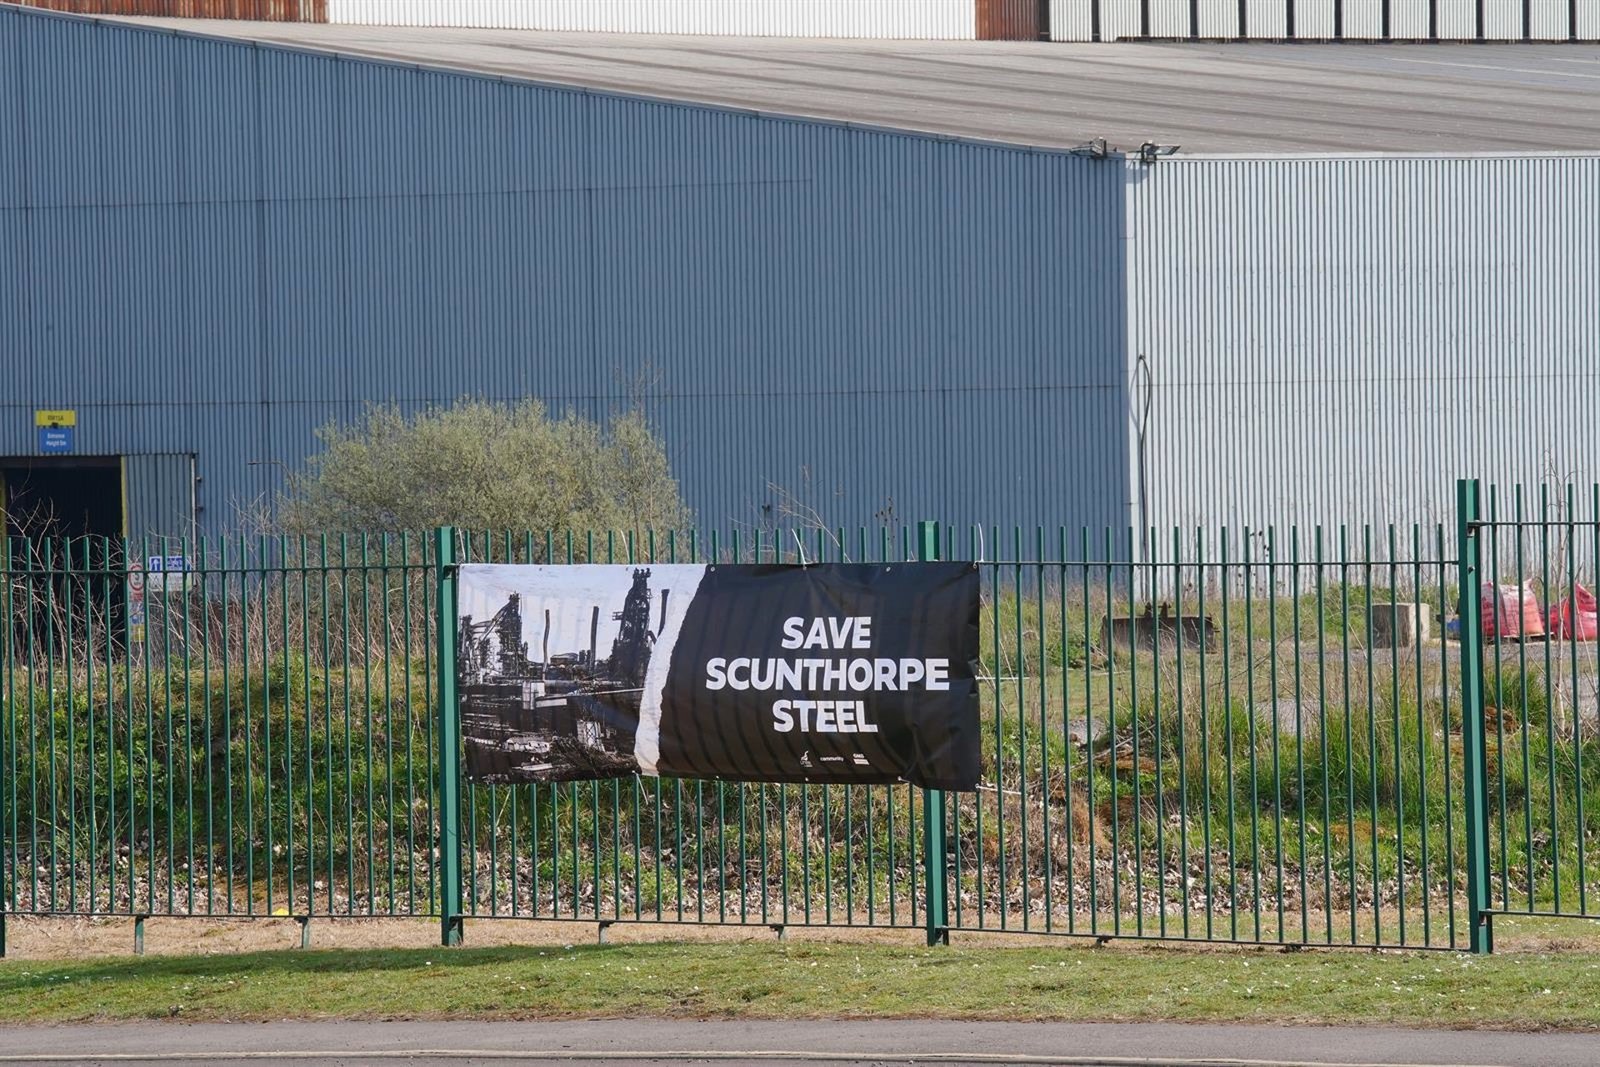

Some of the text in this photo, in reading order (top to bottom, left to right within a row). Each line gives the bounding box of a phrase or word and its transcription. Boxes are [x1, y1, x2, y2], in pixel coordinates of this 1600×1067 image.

[781, 616, 871, 649] SAVE
[705, 657, 950, 691] SCUNTHORPE
[772, 699, 878, 733] STEEL
